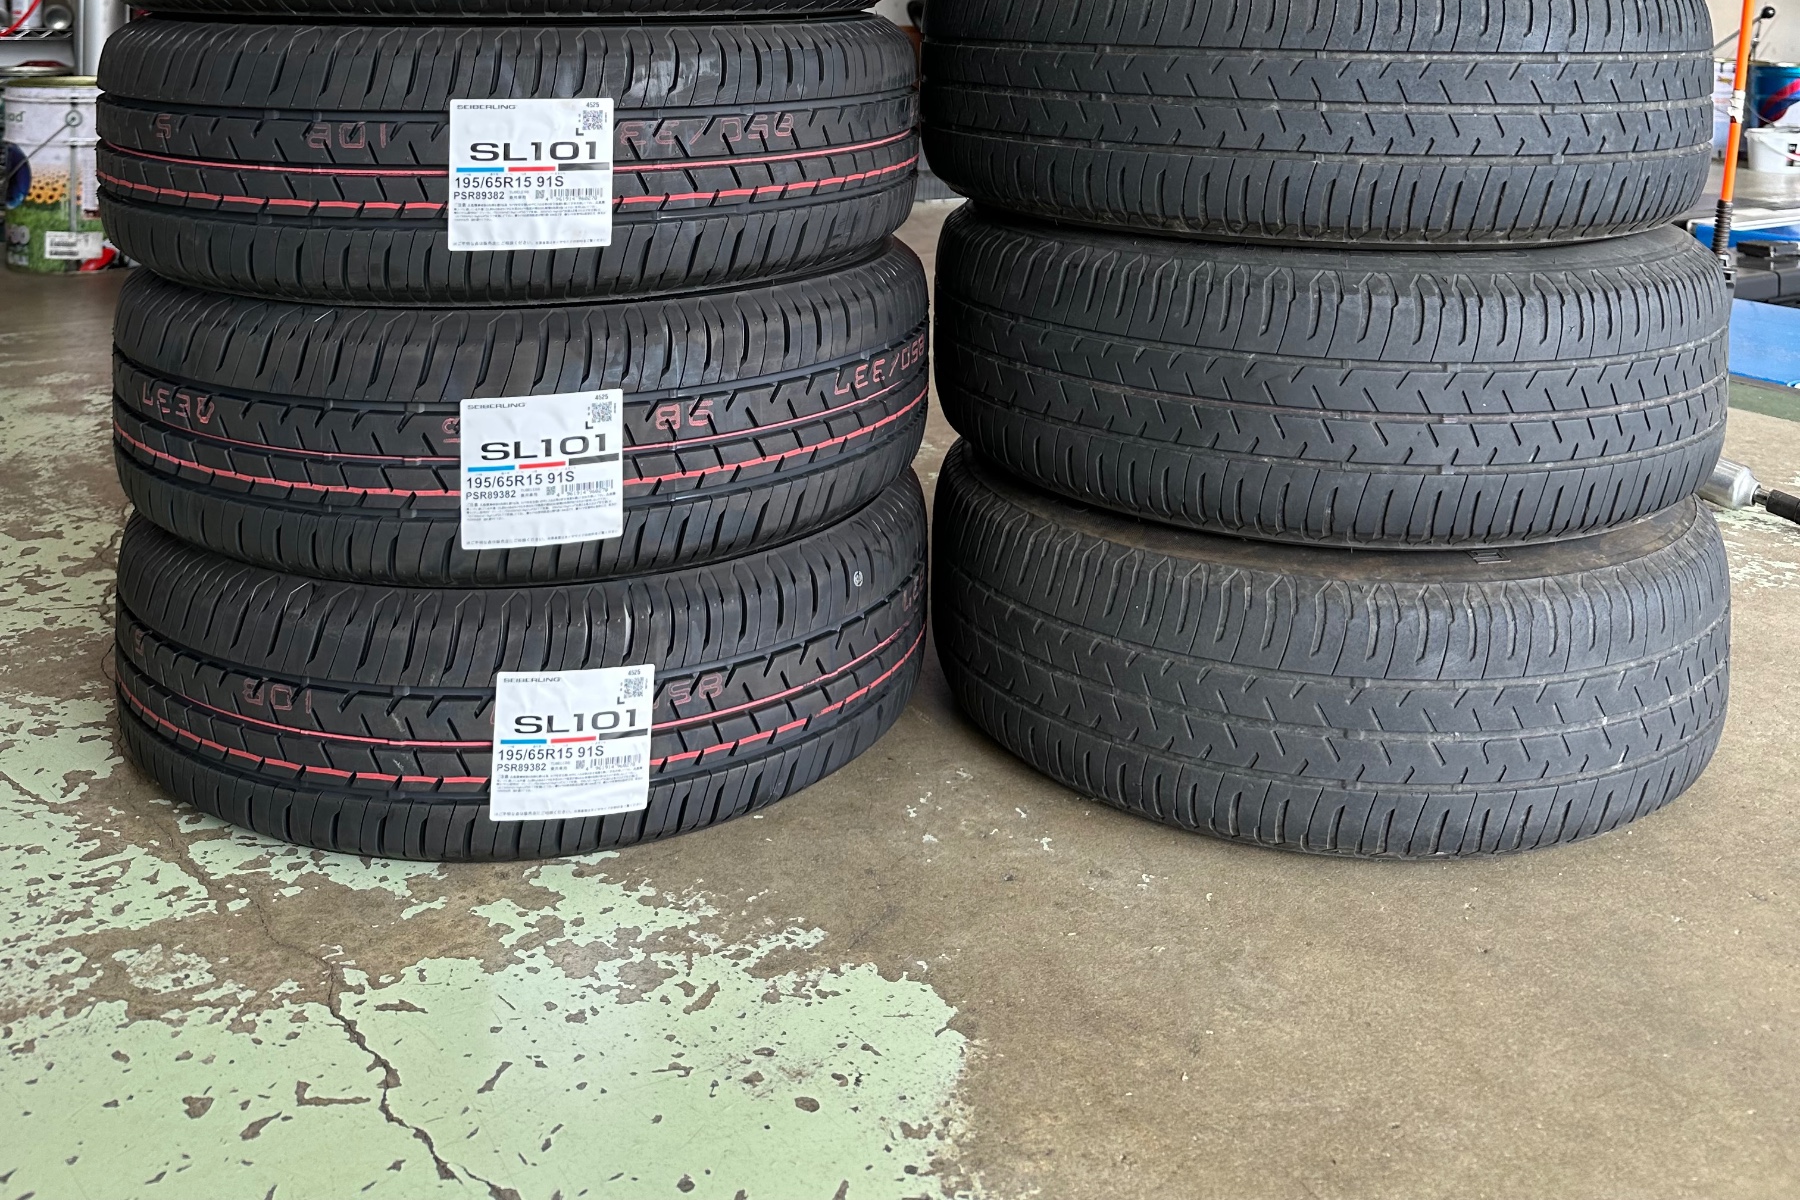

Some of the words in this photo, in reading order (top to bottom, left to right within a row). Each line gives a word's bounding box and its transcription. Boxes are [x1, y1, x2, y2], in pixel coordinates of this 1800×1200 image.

[470, 141, 597, 161] SL101
[454, 176, 532, 189] 195/65R15
[536, 175, 564, 187] 91S
[453, 191, 505, 200] PSR89382
[480, 433, 606, 461] SL101
[466, 473, 543, 489] 195/65R15
[547, 470, 575, 484] 91S
[465, 489, 516, 500] PSR89382
[514, 708, 637, 734] SL101
[498, 747, 573, 761] 195/65R15
[577, 745, 605, 758] 91S
[496, 762, 547, 772] PSR89382
